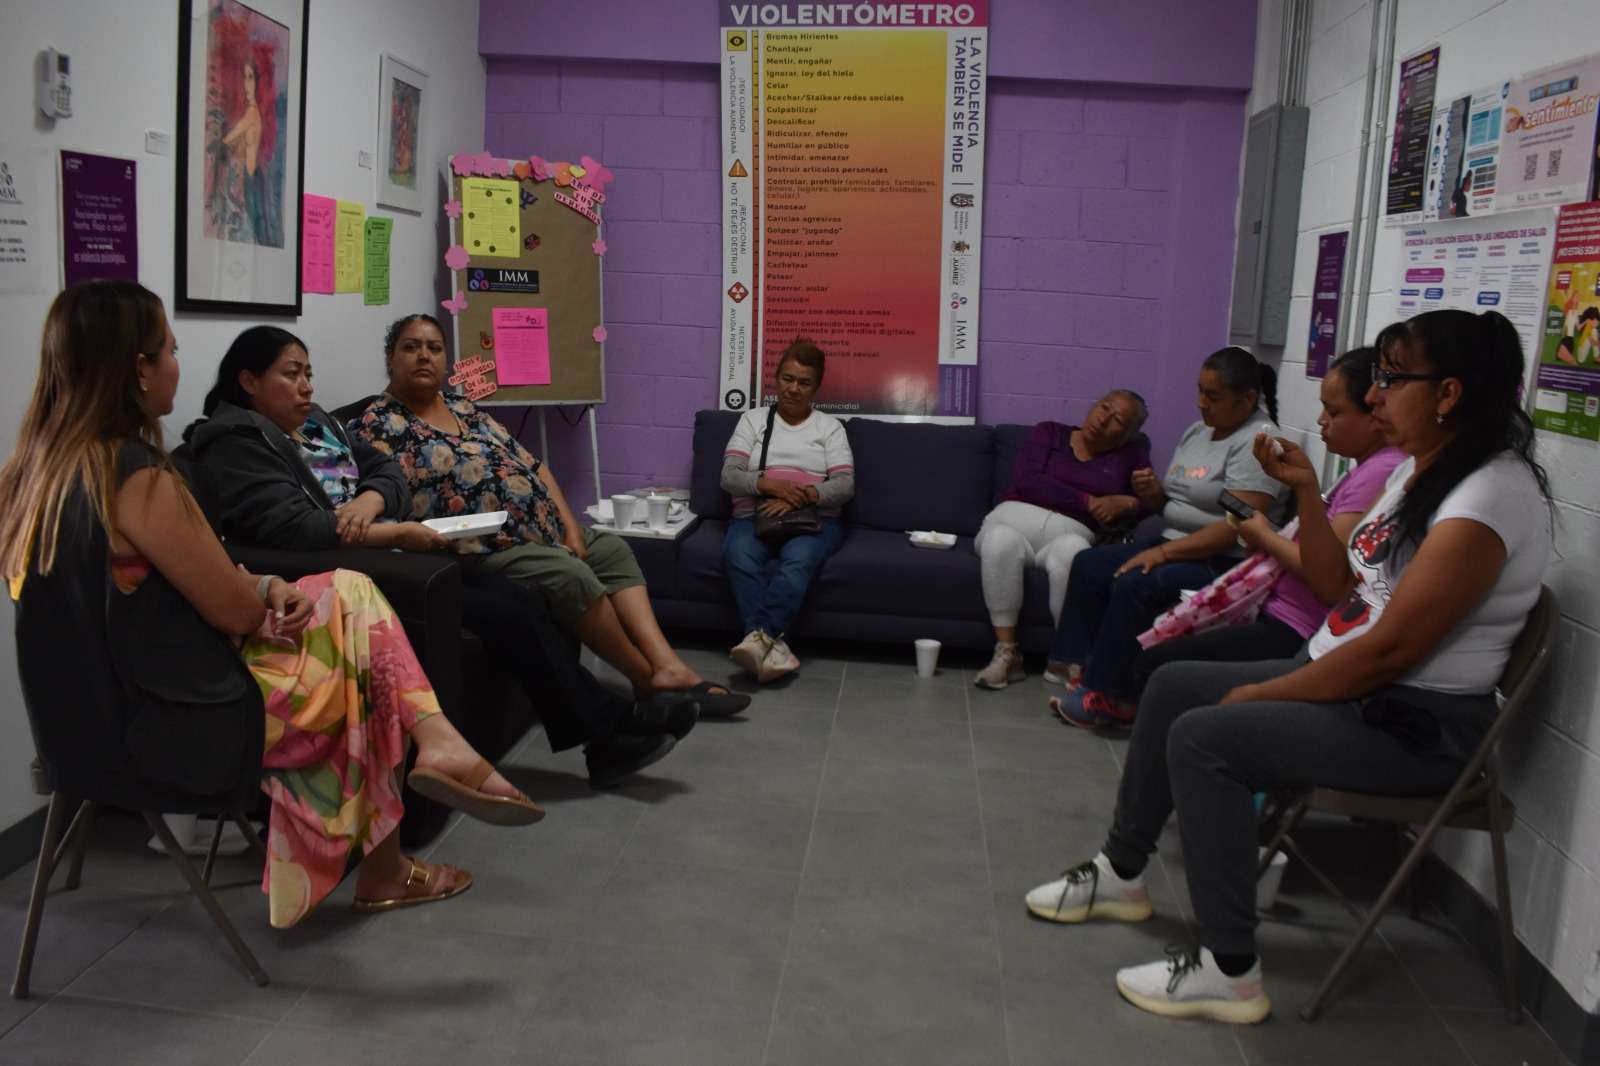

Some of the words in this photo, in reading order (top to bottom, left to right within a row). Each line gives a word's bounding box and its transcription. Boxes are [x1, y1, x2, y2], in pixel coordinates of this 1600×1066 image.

[730, 0, 975, 25] VIOLENTÓMETRO
[766, 45, 812, 54] Chantajear
[970, 36, 982, 57] LA
[798, 57, 832, 66] engañar
[816, 70, 830, 78] del
[832, 70, 854, 78] hielo
[954, 36, 967, 106] TAMBIÉN
[766, 82, 788, 90] Celar
[766, 94, 840, 102] Acechar/Stalkear
[842, 94, 866, 102] redes
[869, 94, 904, 102] sociales
[968, 62, 982, 148] VIOLENCIA
[766, 106, 817, 115] Culpabilizar
[953, 112, 964, 130] SE
[816, 130, 848, 138] ofender
[767, 142, 802, 150] Humillar
[817, 142, 850, 152] público
[952, 136, 964, 173] MIDE
[767, 166, 801, 174] Destruir
[842, 166, 888, 176] personales
[810, 178, 844, 187] prohibir
[730, 182, 738, 195] NO
[731, 197, 738, 208] TE
[767, 215, 802, 223] Caricias
[767, 227, 800, 236] Golpear
[498, 270, 529, 282] IMM
[956, 320, 968, 350] IMM
